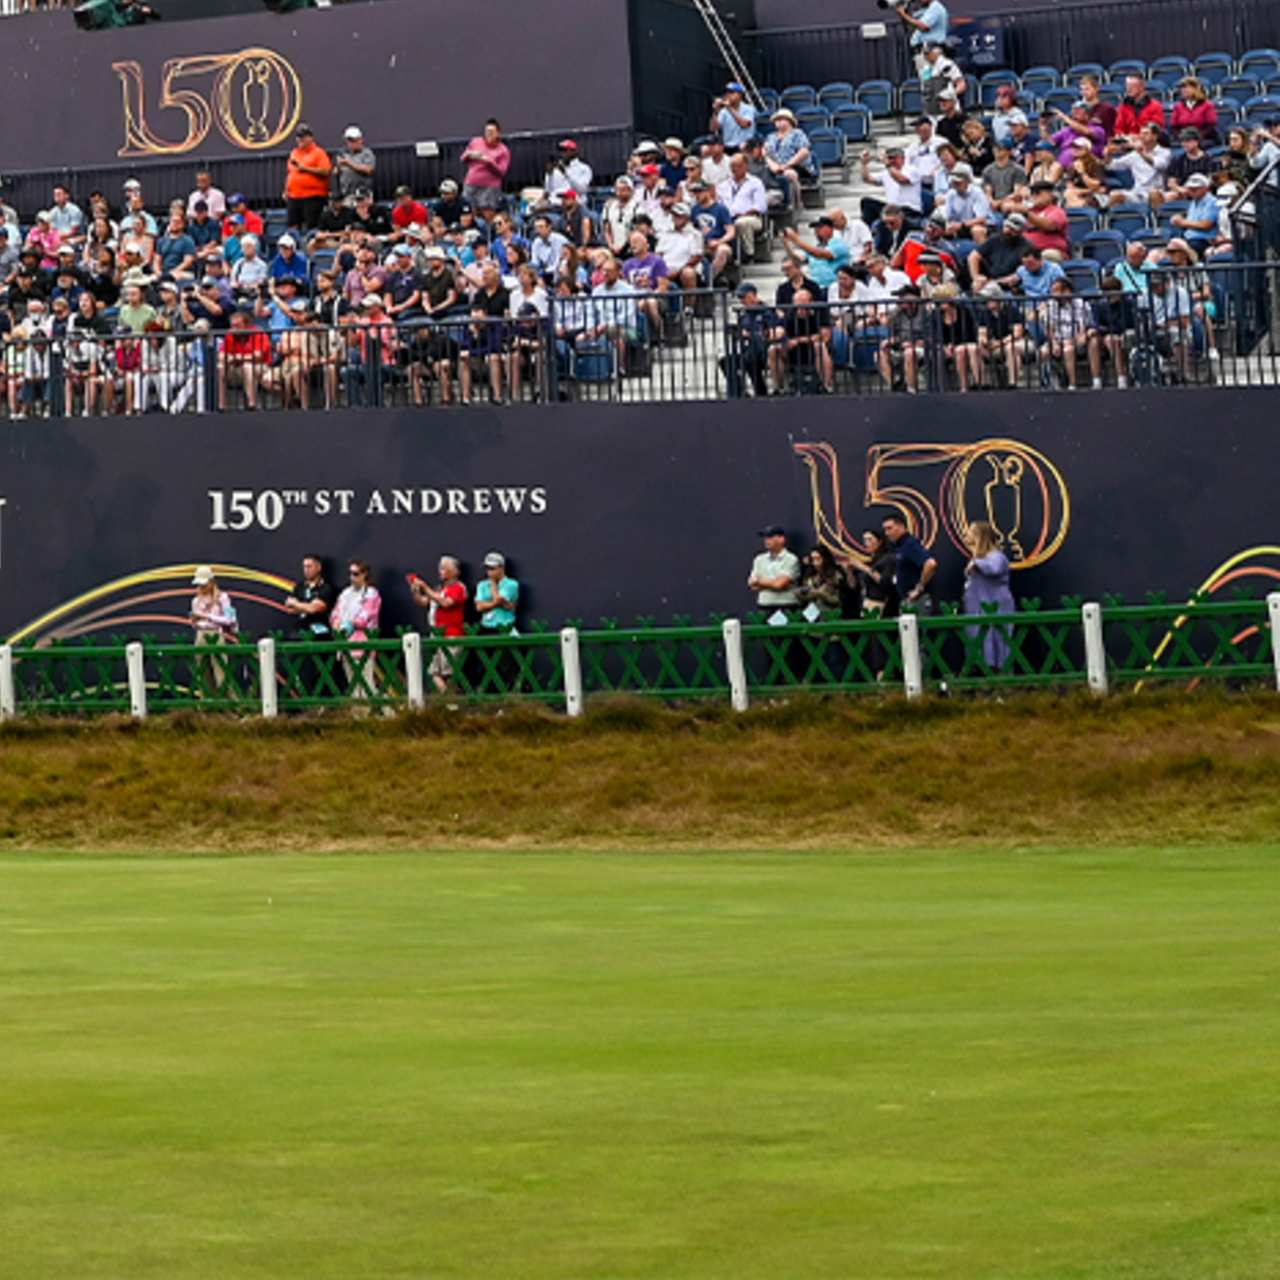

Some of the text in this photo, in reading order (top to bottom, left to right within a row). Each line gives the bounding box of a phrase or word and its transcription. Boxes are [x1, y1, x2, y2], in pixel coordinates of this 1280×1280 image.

[111, 46, 302, 157] 150
[313, 489, 354, 515] ST
[366, 487, 548, 515] ANDREWS
[793, 437, 1071, 571] 150
